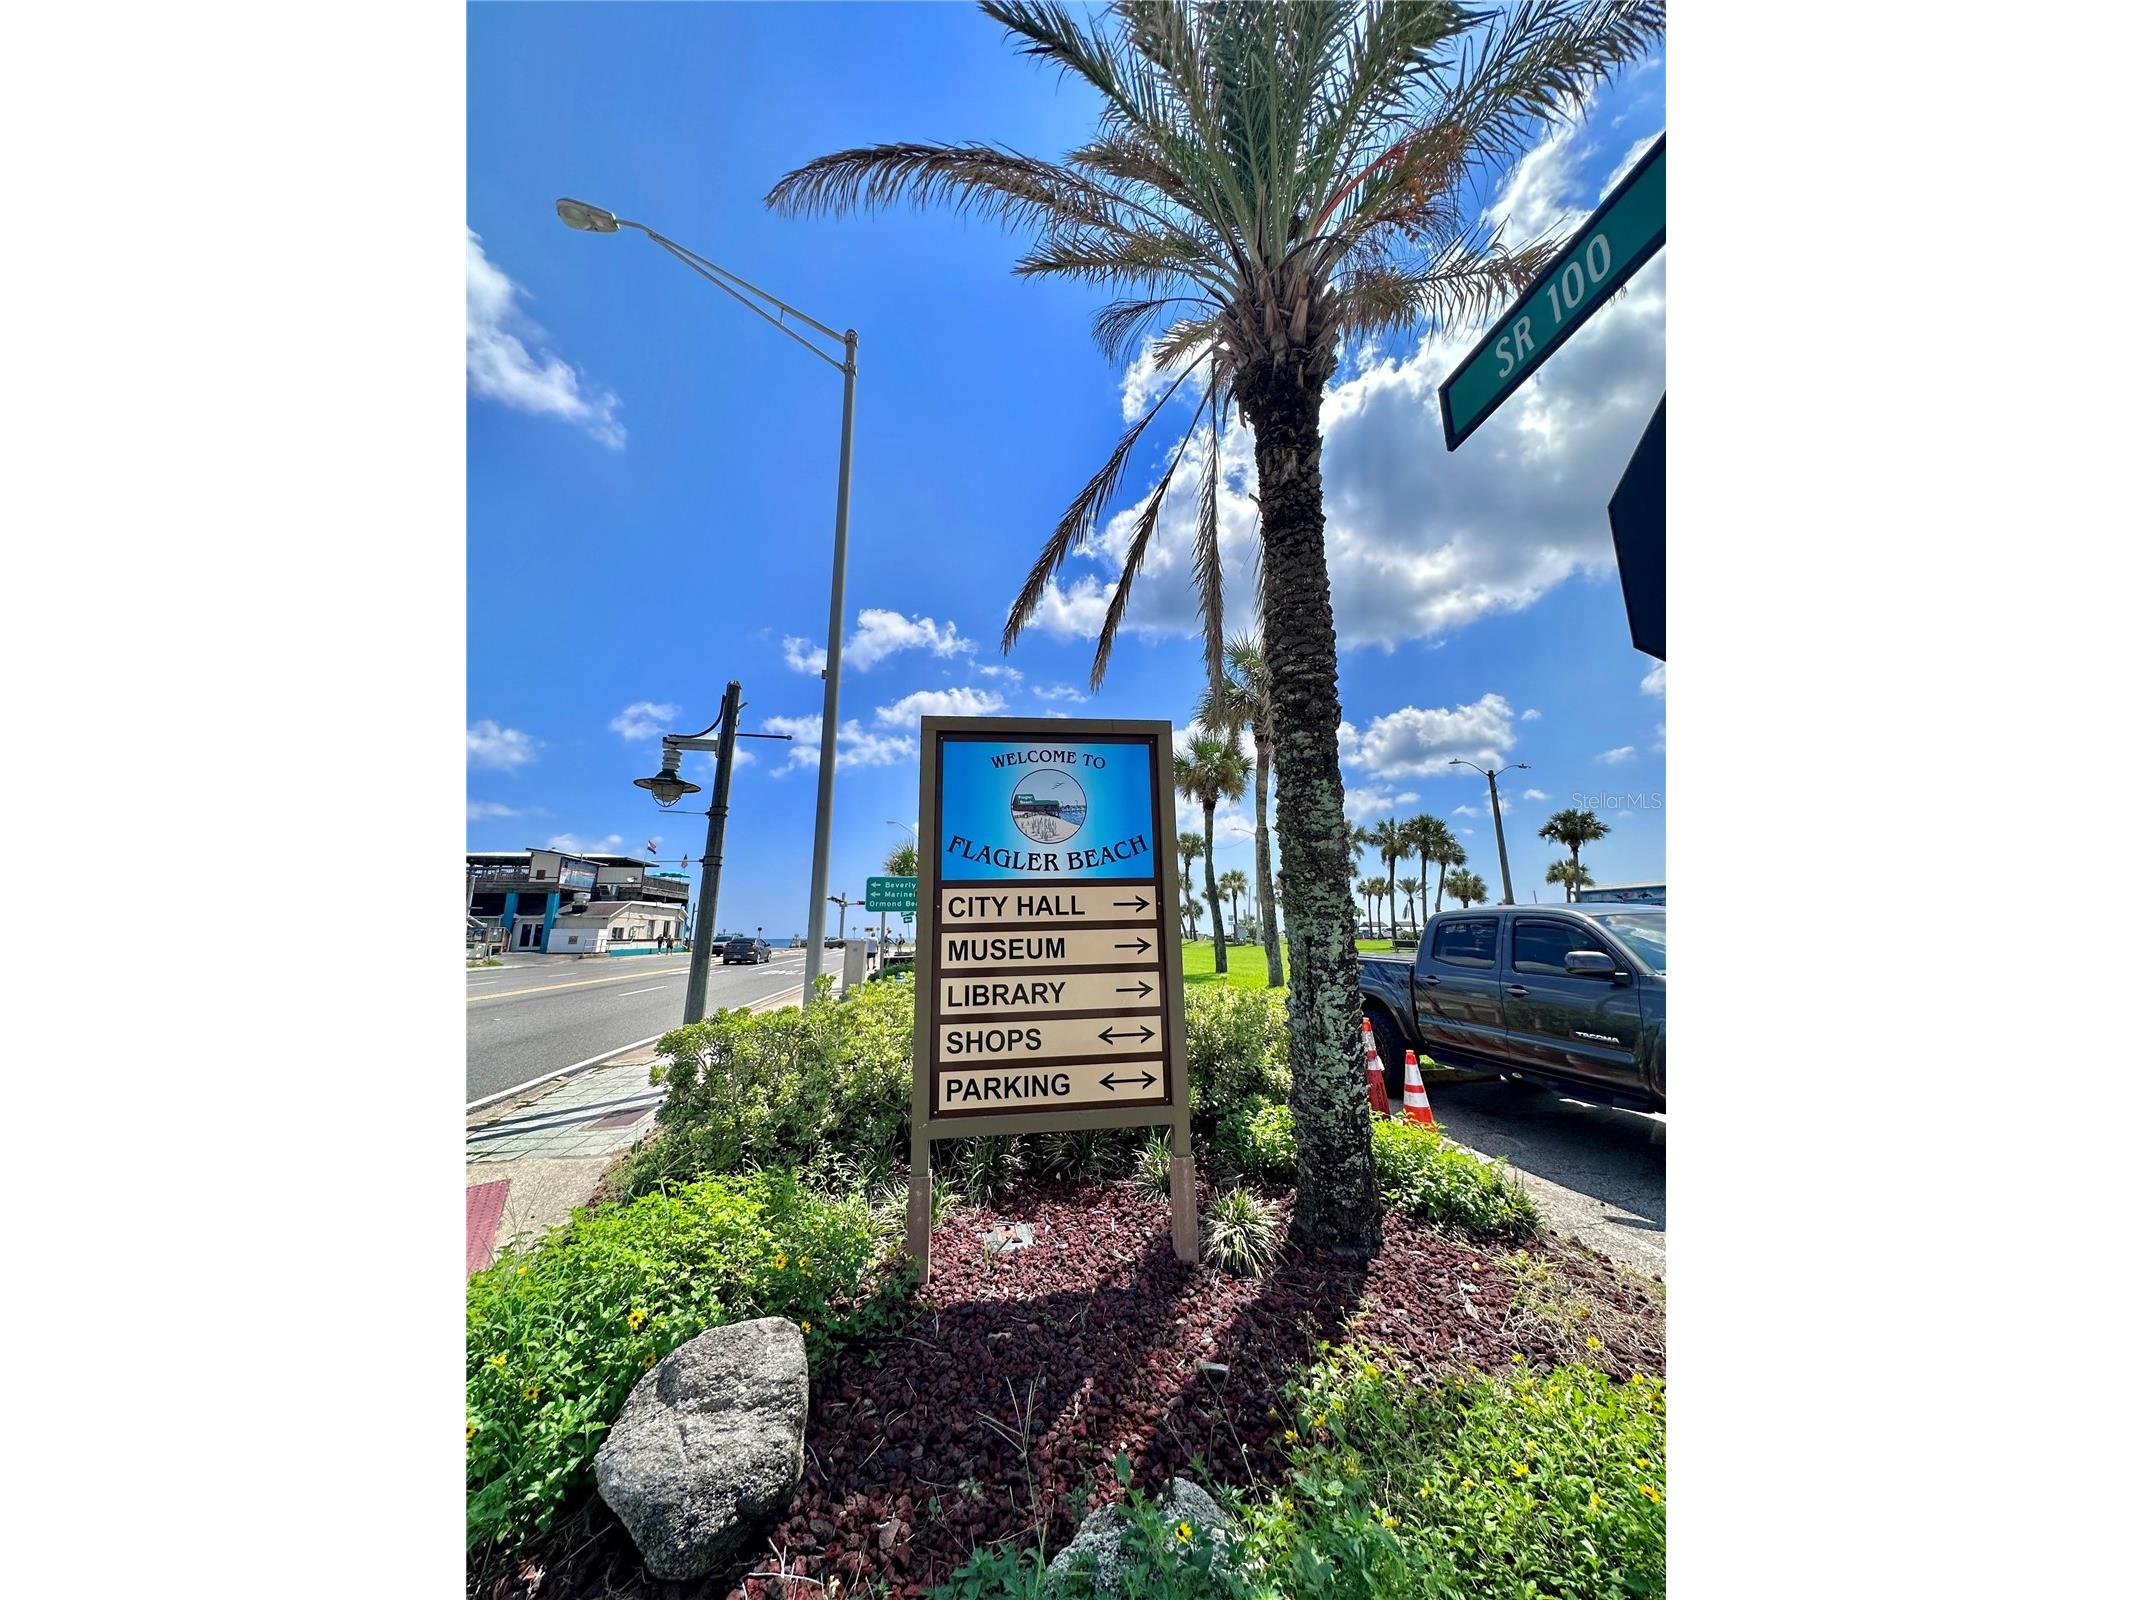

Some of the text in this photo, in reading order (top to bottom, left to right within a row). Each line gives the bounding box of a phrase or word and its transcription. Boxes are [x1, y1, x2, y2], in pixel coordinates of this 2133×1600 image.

[1495, 233, 1611, 378] SR 100
[991, 750, 1106, 770] WELCOME TO
[947, 834, 1149, 872] FLAGLER BEACH
[885, 881, 916, 889] Beverly
[948, 895, 1085, 918] CITY HALL
[948, 937, 1065, 961] MUSEUM
[947, 982, 1065, 1007] LIBRARY
[946, 1028, 1042, 1054] SHOPS
[946, 1073, 1070, 1102] PARKING
